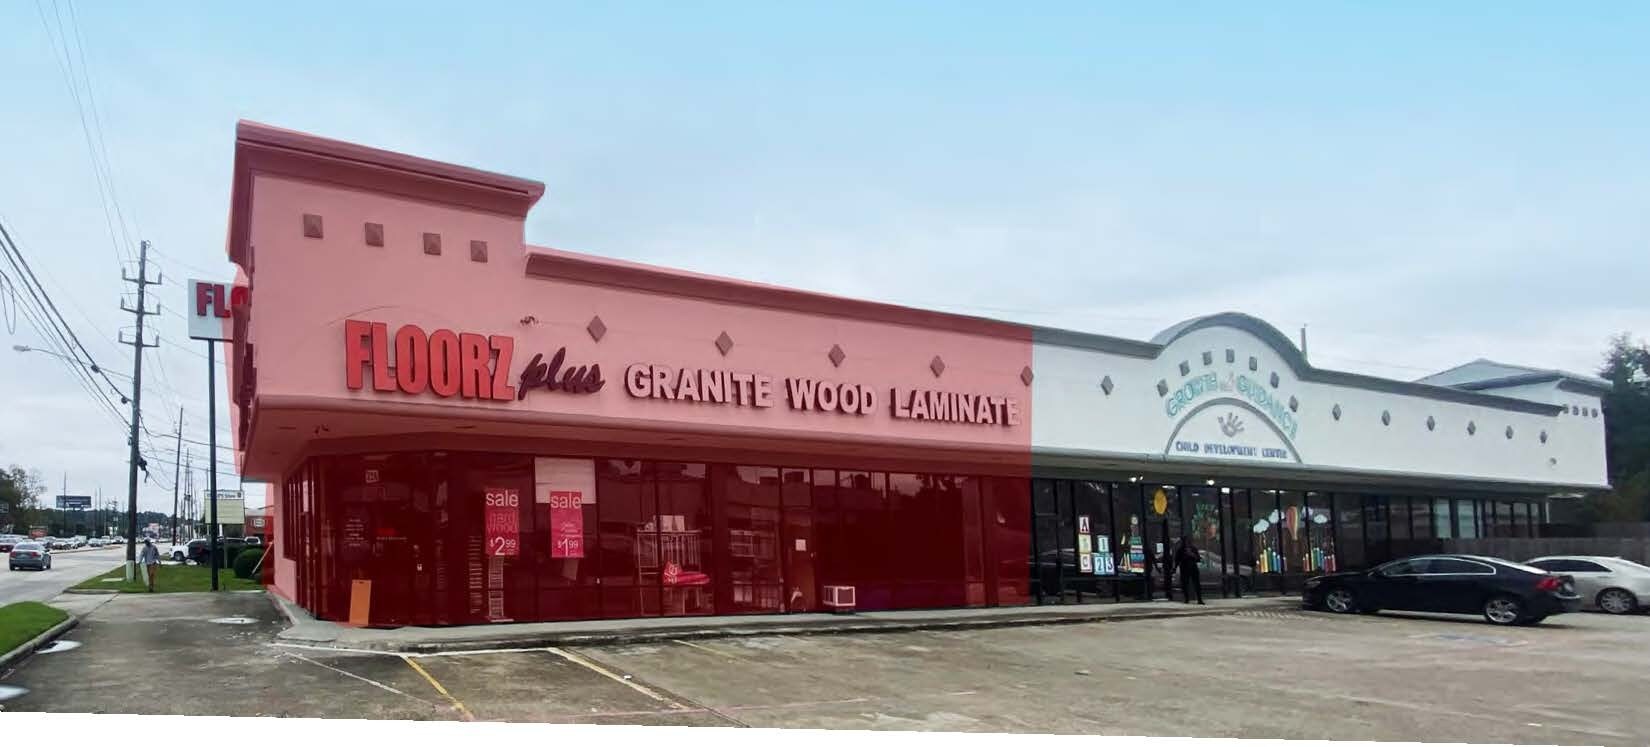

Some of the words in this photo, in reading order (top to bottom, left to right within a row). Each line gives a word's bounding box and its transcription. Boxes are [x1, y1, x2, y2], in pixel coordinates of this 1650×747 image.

[345, 319, 516, 401] FLOORZ
[518, 347, 605, 400] plus
[625, 363, 774, 408] GRANITE
[786, 377, 878, 415] WOOD
[890, 387, 1021, 425] LAMINATE
[486, 490, 518, 507] sale
[551, 493, 582, 509] sale
